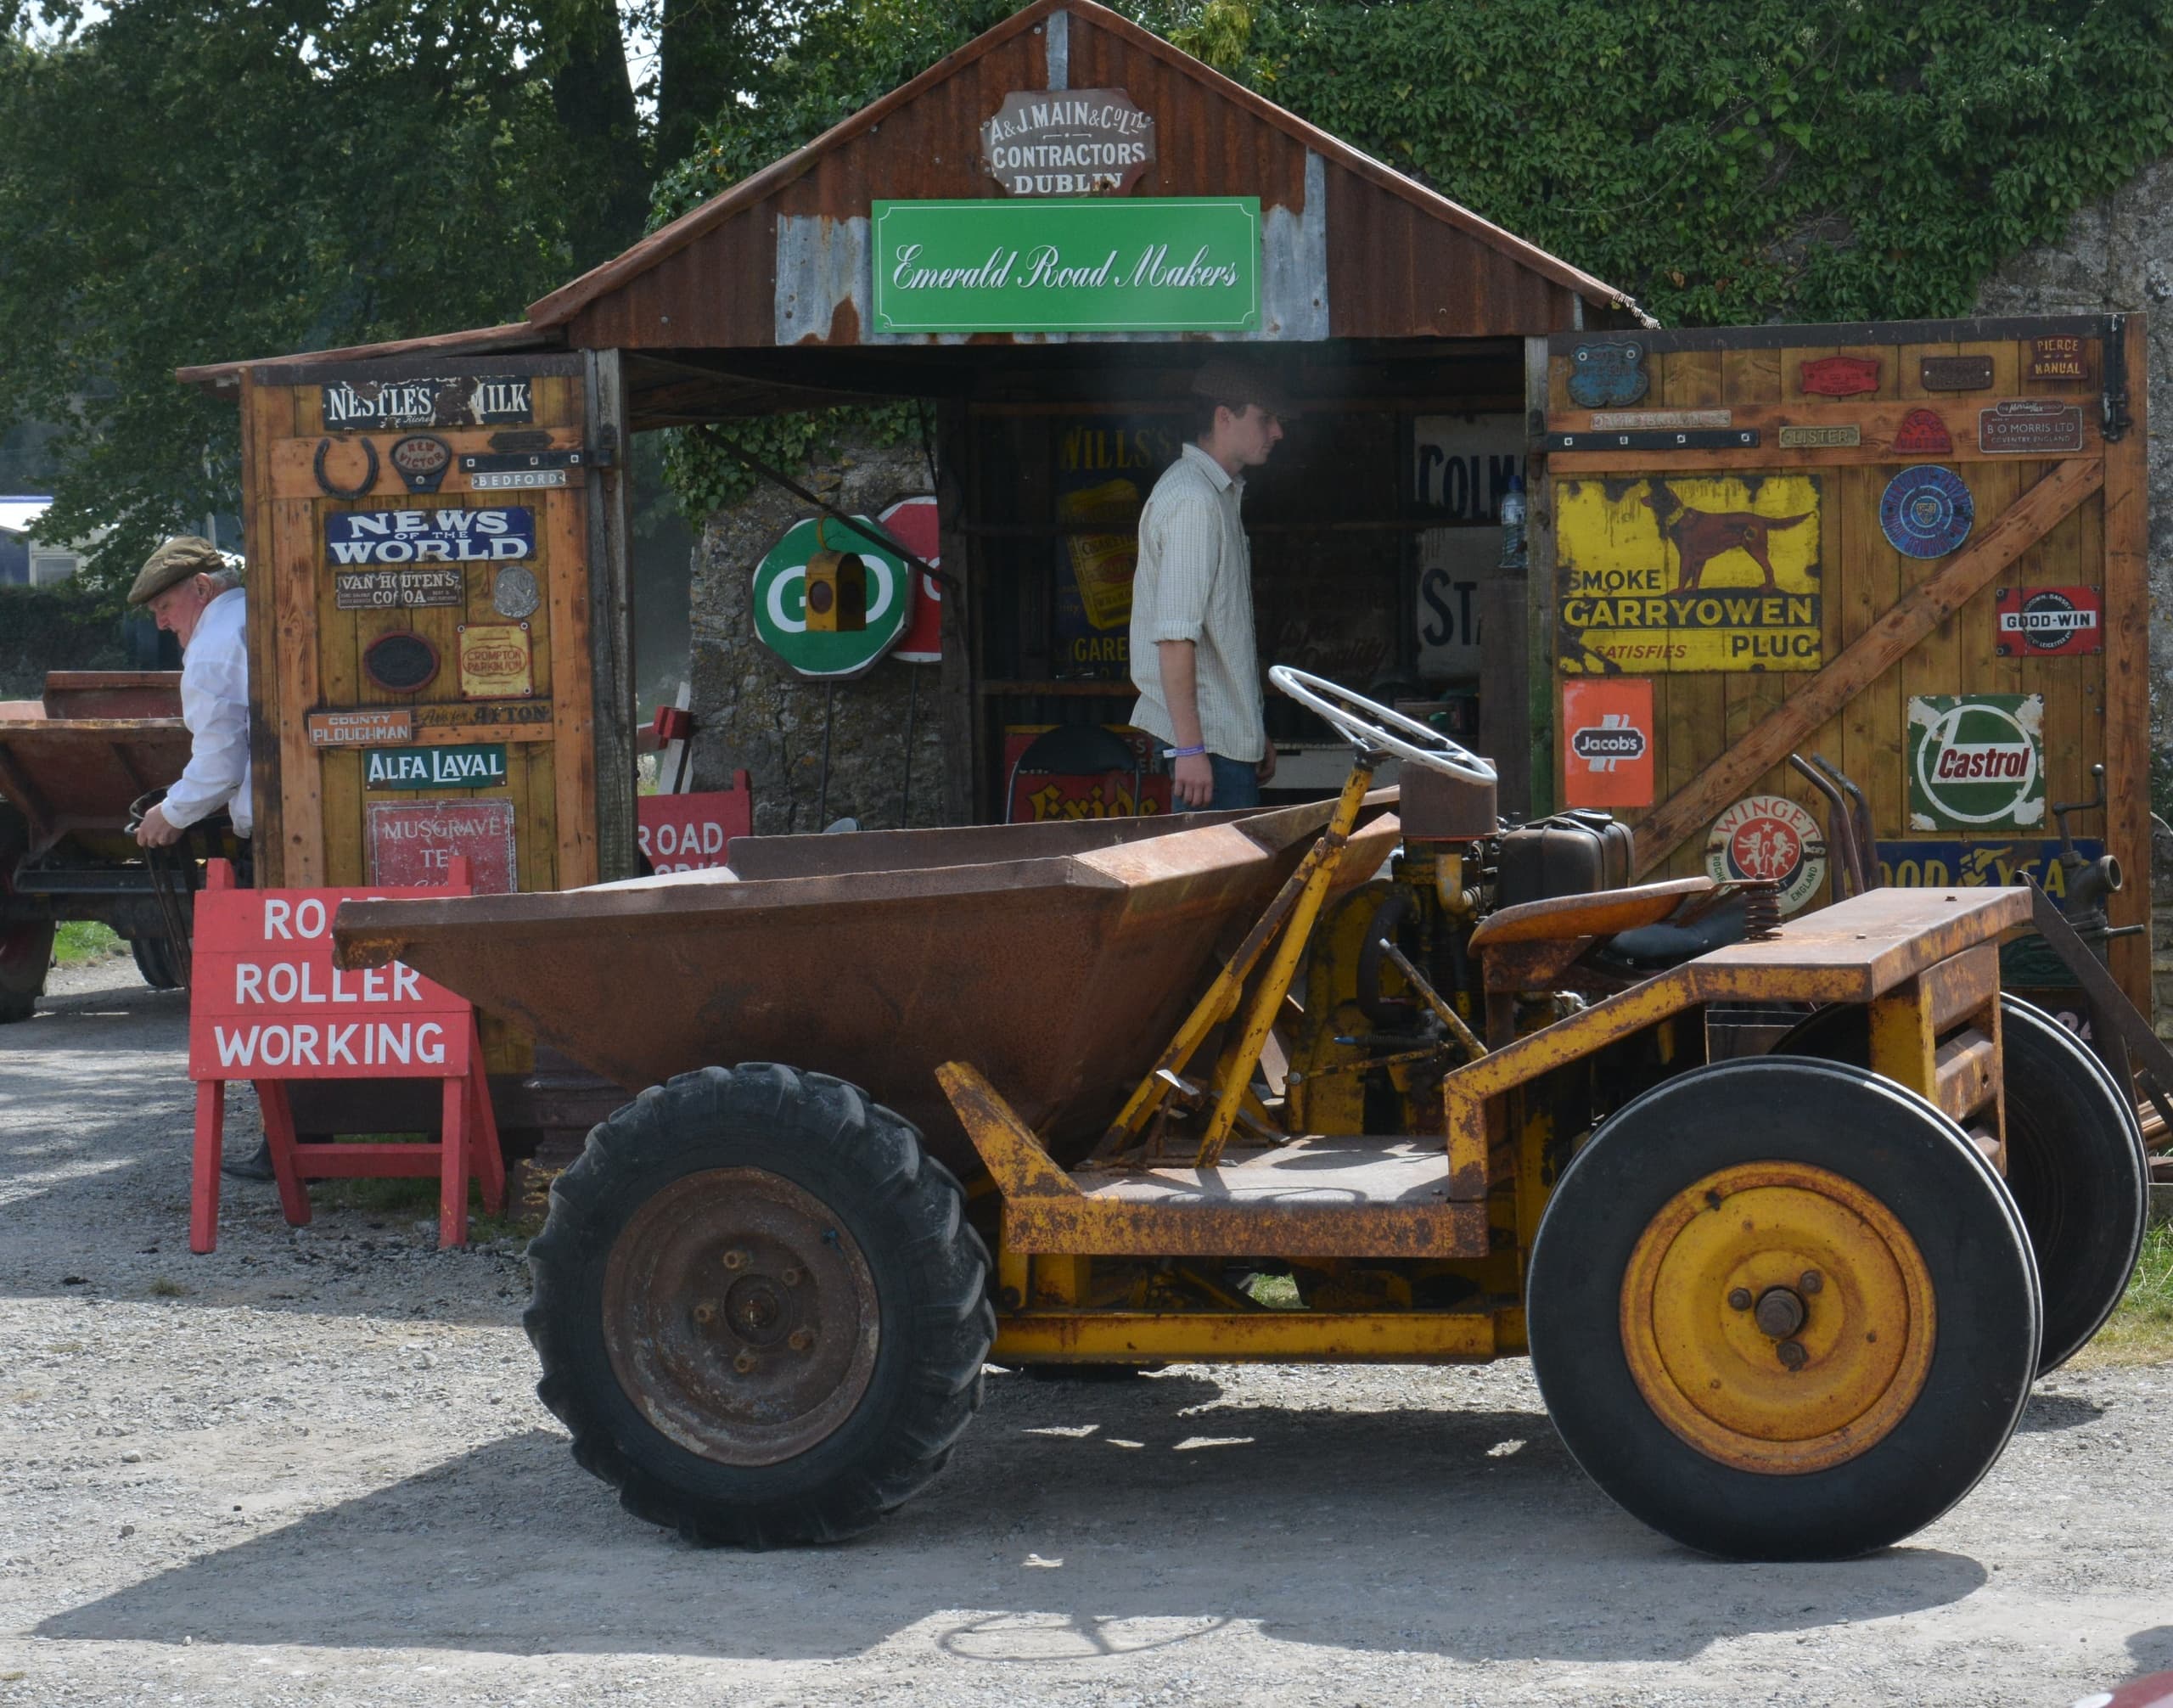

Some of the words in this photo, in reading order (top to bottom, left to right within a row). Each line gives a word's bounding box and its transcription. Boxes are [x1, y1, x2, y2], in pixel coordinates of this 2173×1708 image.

[992, 143, 1146, 169] CONTRACTORS
[1014, 172, 1123, 194] DUBLIN
[892, 243, 1018, 291] Emerald
[1017, 244, 1116, 289] Road
[1114, 243, 1240, 289] Makers
[2037, 339, 2080, 352] PIERCE
[1792, 428, 1850, 444] LISTER
[1987, 424, 1994, 434] B
[2009, 423, 2052, 434] MORRIS
[2054, 423, 2075, 432] LTD
[407, 441, 436, 453] NEW
[399, 452, 444, 469] VICTOR
[479, 473, 558, 487] BEDFORD
[346, 510, 508, 539] NEWS
[394, 532, 420, 541] OF
[432, 531, 469, 539] THE
[330, 537, 529, 565] WORLD
[341, 576, 373, 590] VAN
[1569, 569, 1662, 593] SMOKE
[1421, 568, 1481, 647] ST
[1564, 597, 1813, 627] GARRYOWEN
[2006, 613, 2091, 628] GOOD-WIN
[468, 650, 521, 661] CROMPTON
[1593, 643, 1687, 660] SATISFIES
[1732, 634, 1813, 658] PLUG
[328, 715, 390, 726] COUNTY
[312, 725, 408, 742] PLOUGHMAN
[1581, 736, 1638, 752] Jacob's
[368, 753, 429, 783] ALFA
[432, 750, 504, 783] LAVAL
[1937, 746, 2031, 778] Castrol
[384, 817, 502, 840] MUSGRAVE
[1715, 797, 1822, 840] WINGET
[637, 822, 724, 857] ROAD
[419, 847, 459, 868] TE
[1789, 865, 1818, 902] ENGLAND
[1995, 858, 2091, 898] YEA
[235, 959, 423, 1004] ROLLER
[214, 1022, 446, 1067] WORKING
